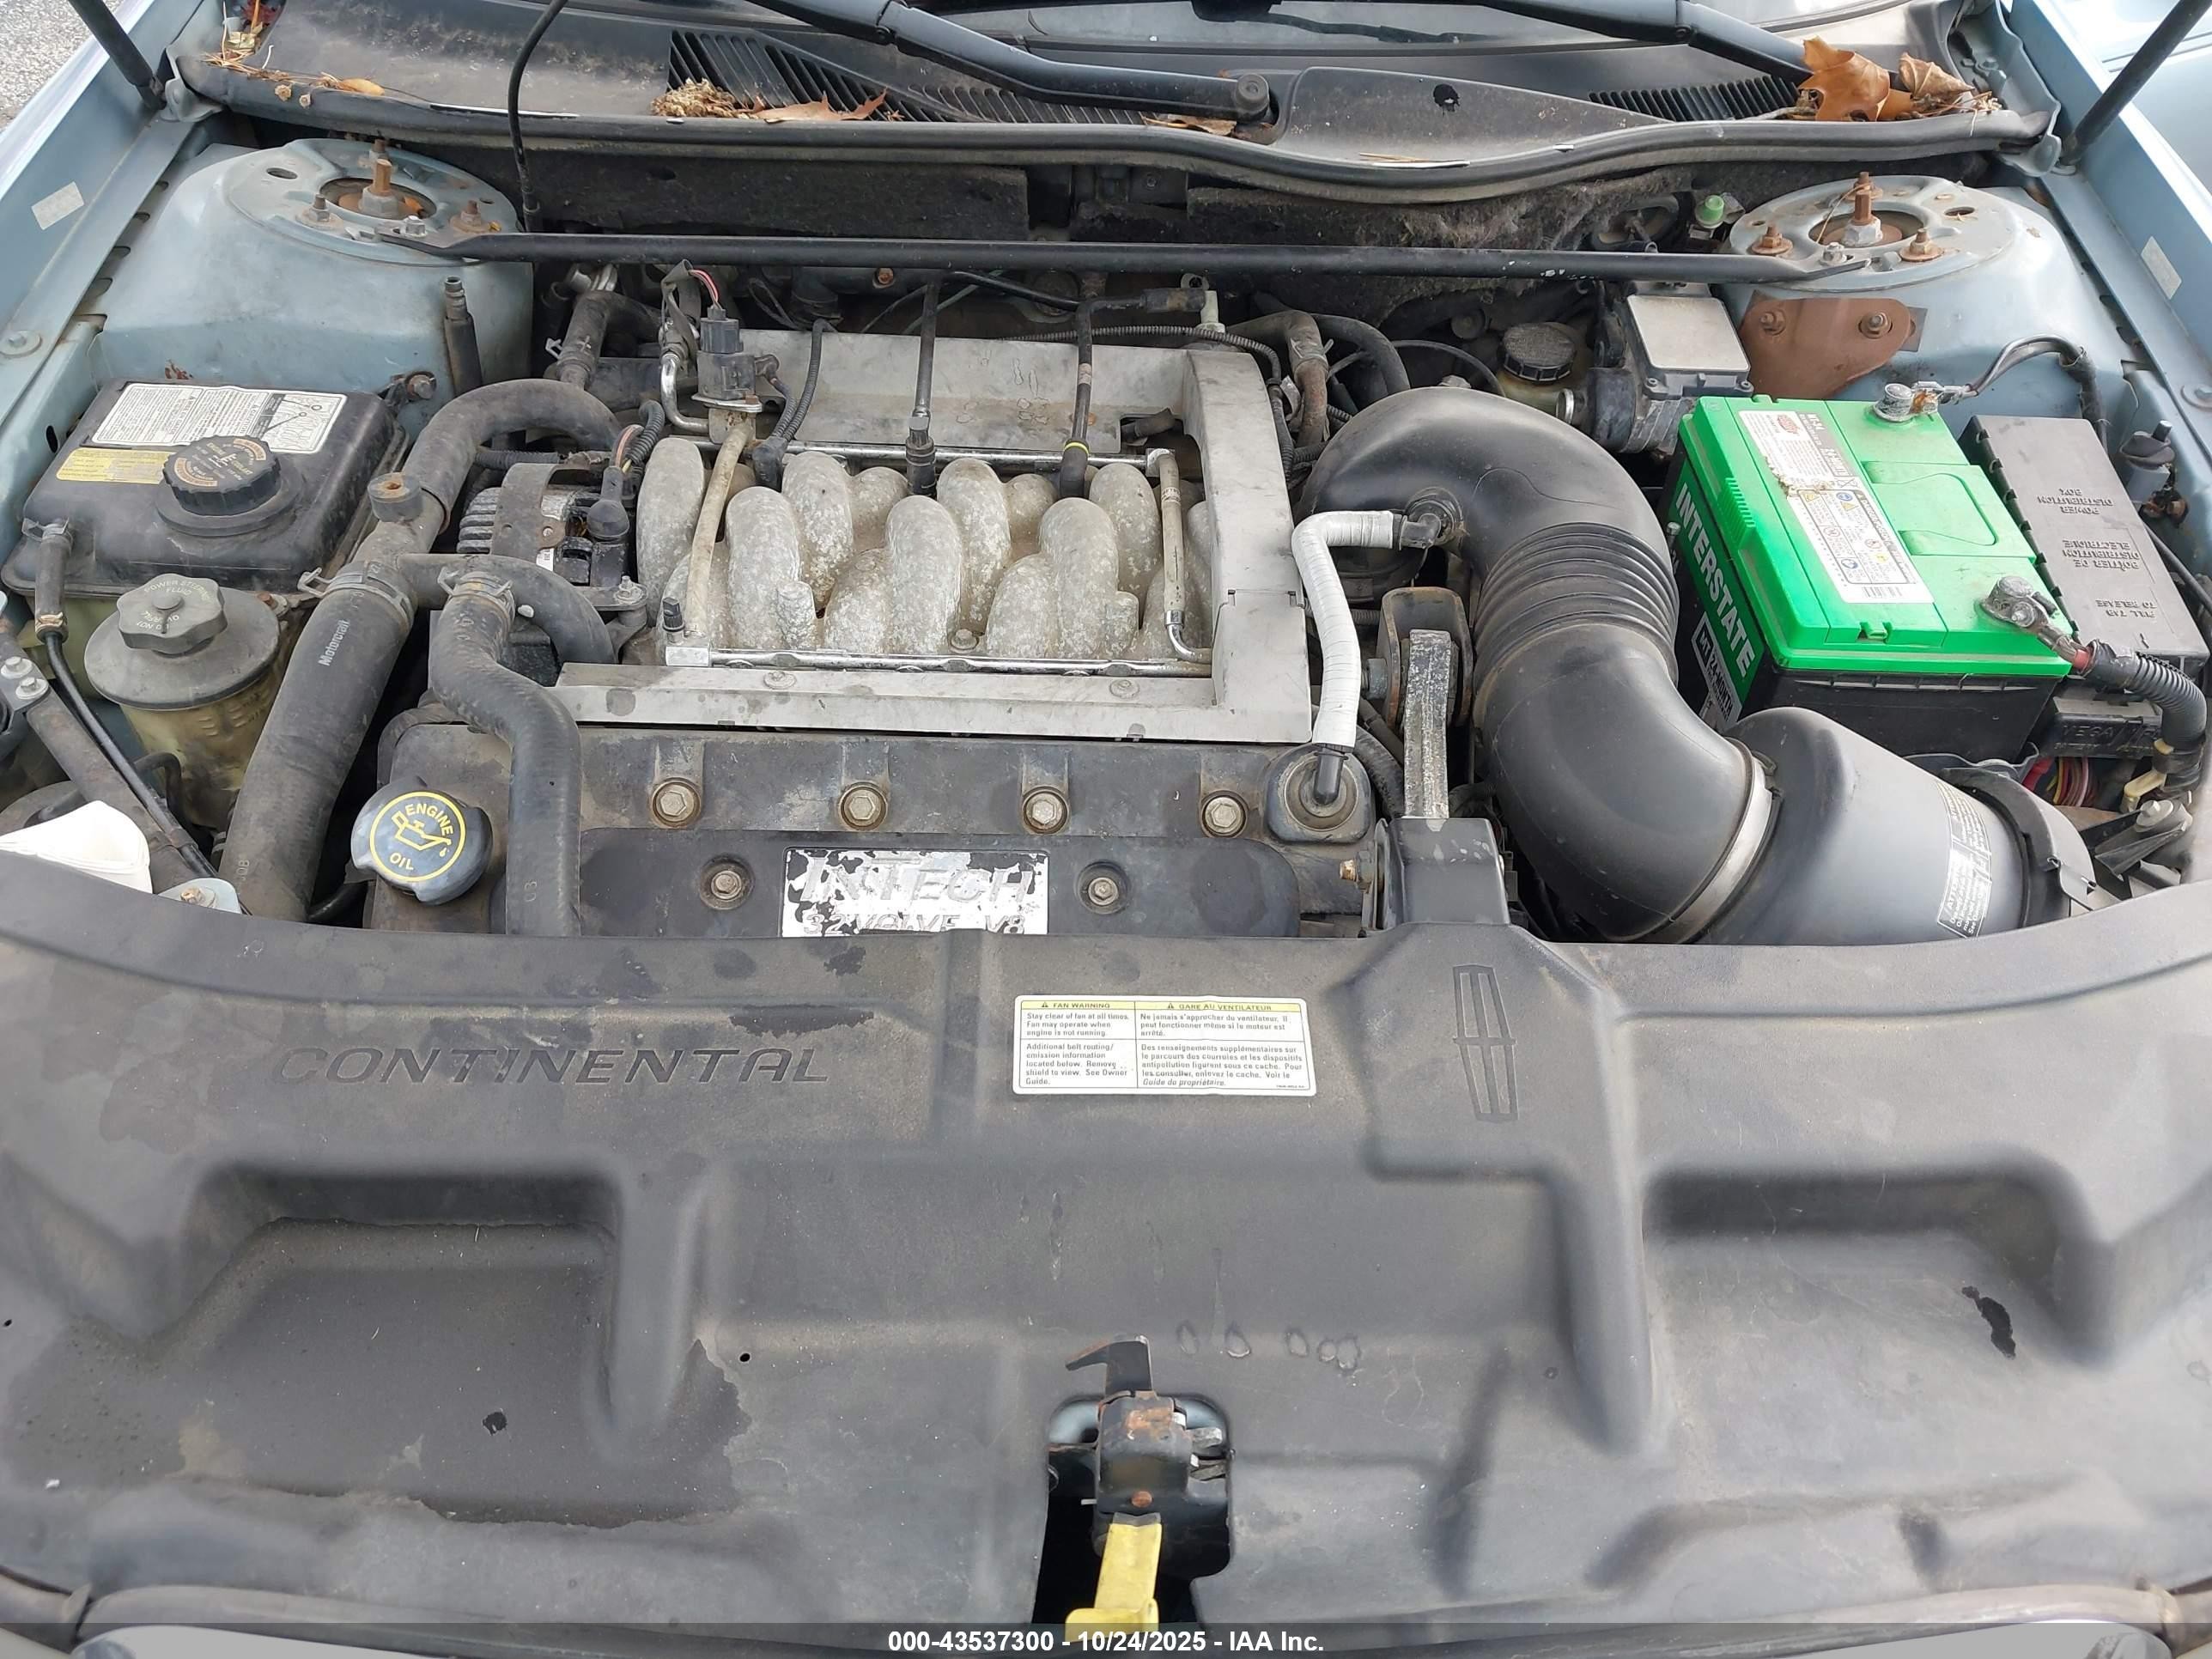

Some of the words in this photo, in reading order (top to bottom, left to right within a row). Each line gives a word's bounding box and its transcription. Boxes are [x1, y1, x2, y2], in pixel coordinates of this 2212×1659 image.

[2059, 488, 2083, 496] BOX
[2037, 496, 2114, 507] DISTRIBUTION
[2060, 506, 2100, 515] POWER
[2063, 549, 2142, 560] DISTRIBUTION
[2074, 559, 2088, 568] DE
[1675, 482, 1756, 678] INTERSTATE
[2095, 599, 2139, 608] RELEASE
[2142, 601, 2157, 610] TO
[2106, 609, 2127, 617] TAB
[2130, 609, 2156, 618] PULL
[318, 619, 350, 666] Motorcraft
[1699, 630, 1711, 656] MT
[1709, 653, 1733, 717] 24-MONTH
[404, 804, 454, 836] ENGINE
[390, 852, 415, 871] OIL
[986, 914, 1025, 935] V8
[1968, 921, 1977, 934] See
[1152, 1013, 1177, 1022] jamais
[1180, 1013, 1224, 1022] s'approcher
[1220, 1045, 1283, 1054] supplémentaires
[272, 1047, 829, 1085] CONTINENTAL
[1179, 1079, 1226, 1087] propriétaire.
